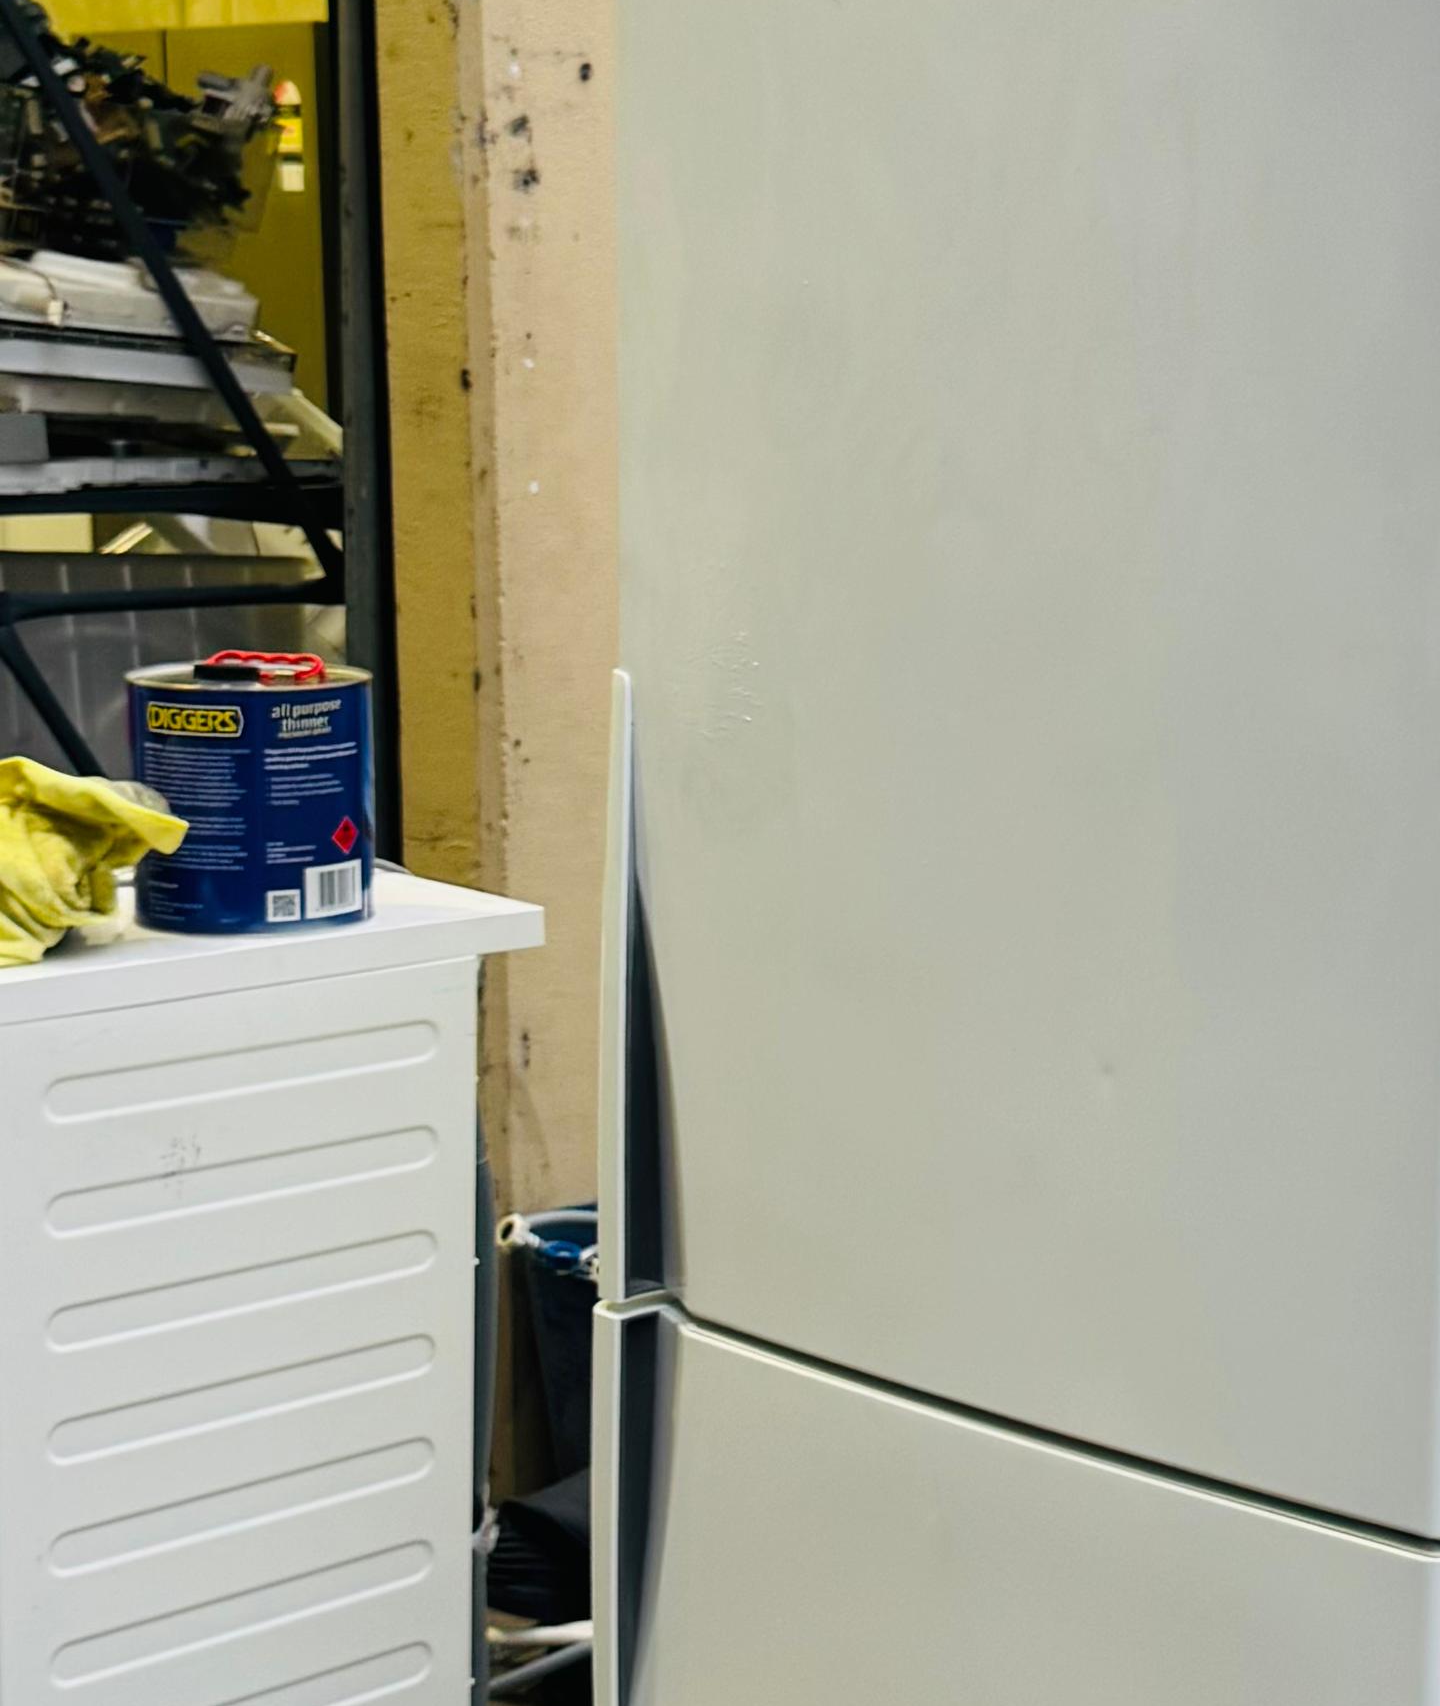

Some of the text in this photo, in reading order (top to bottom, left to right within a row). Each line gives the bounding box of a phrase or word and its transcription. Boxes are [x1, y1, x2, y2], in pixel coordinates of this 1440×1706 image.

[271, 698, 343, 719] all purpose
[149, 706, 238, 733] DIGGERS
[281, 715, 330, 732] thinner
